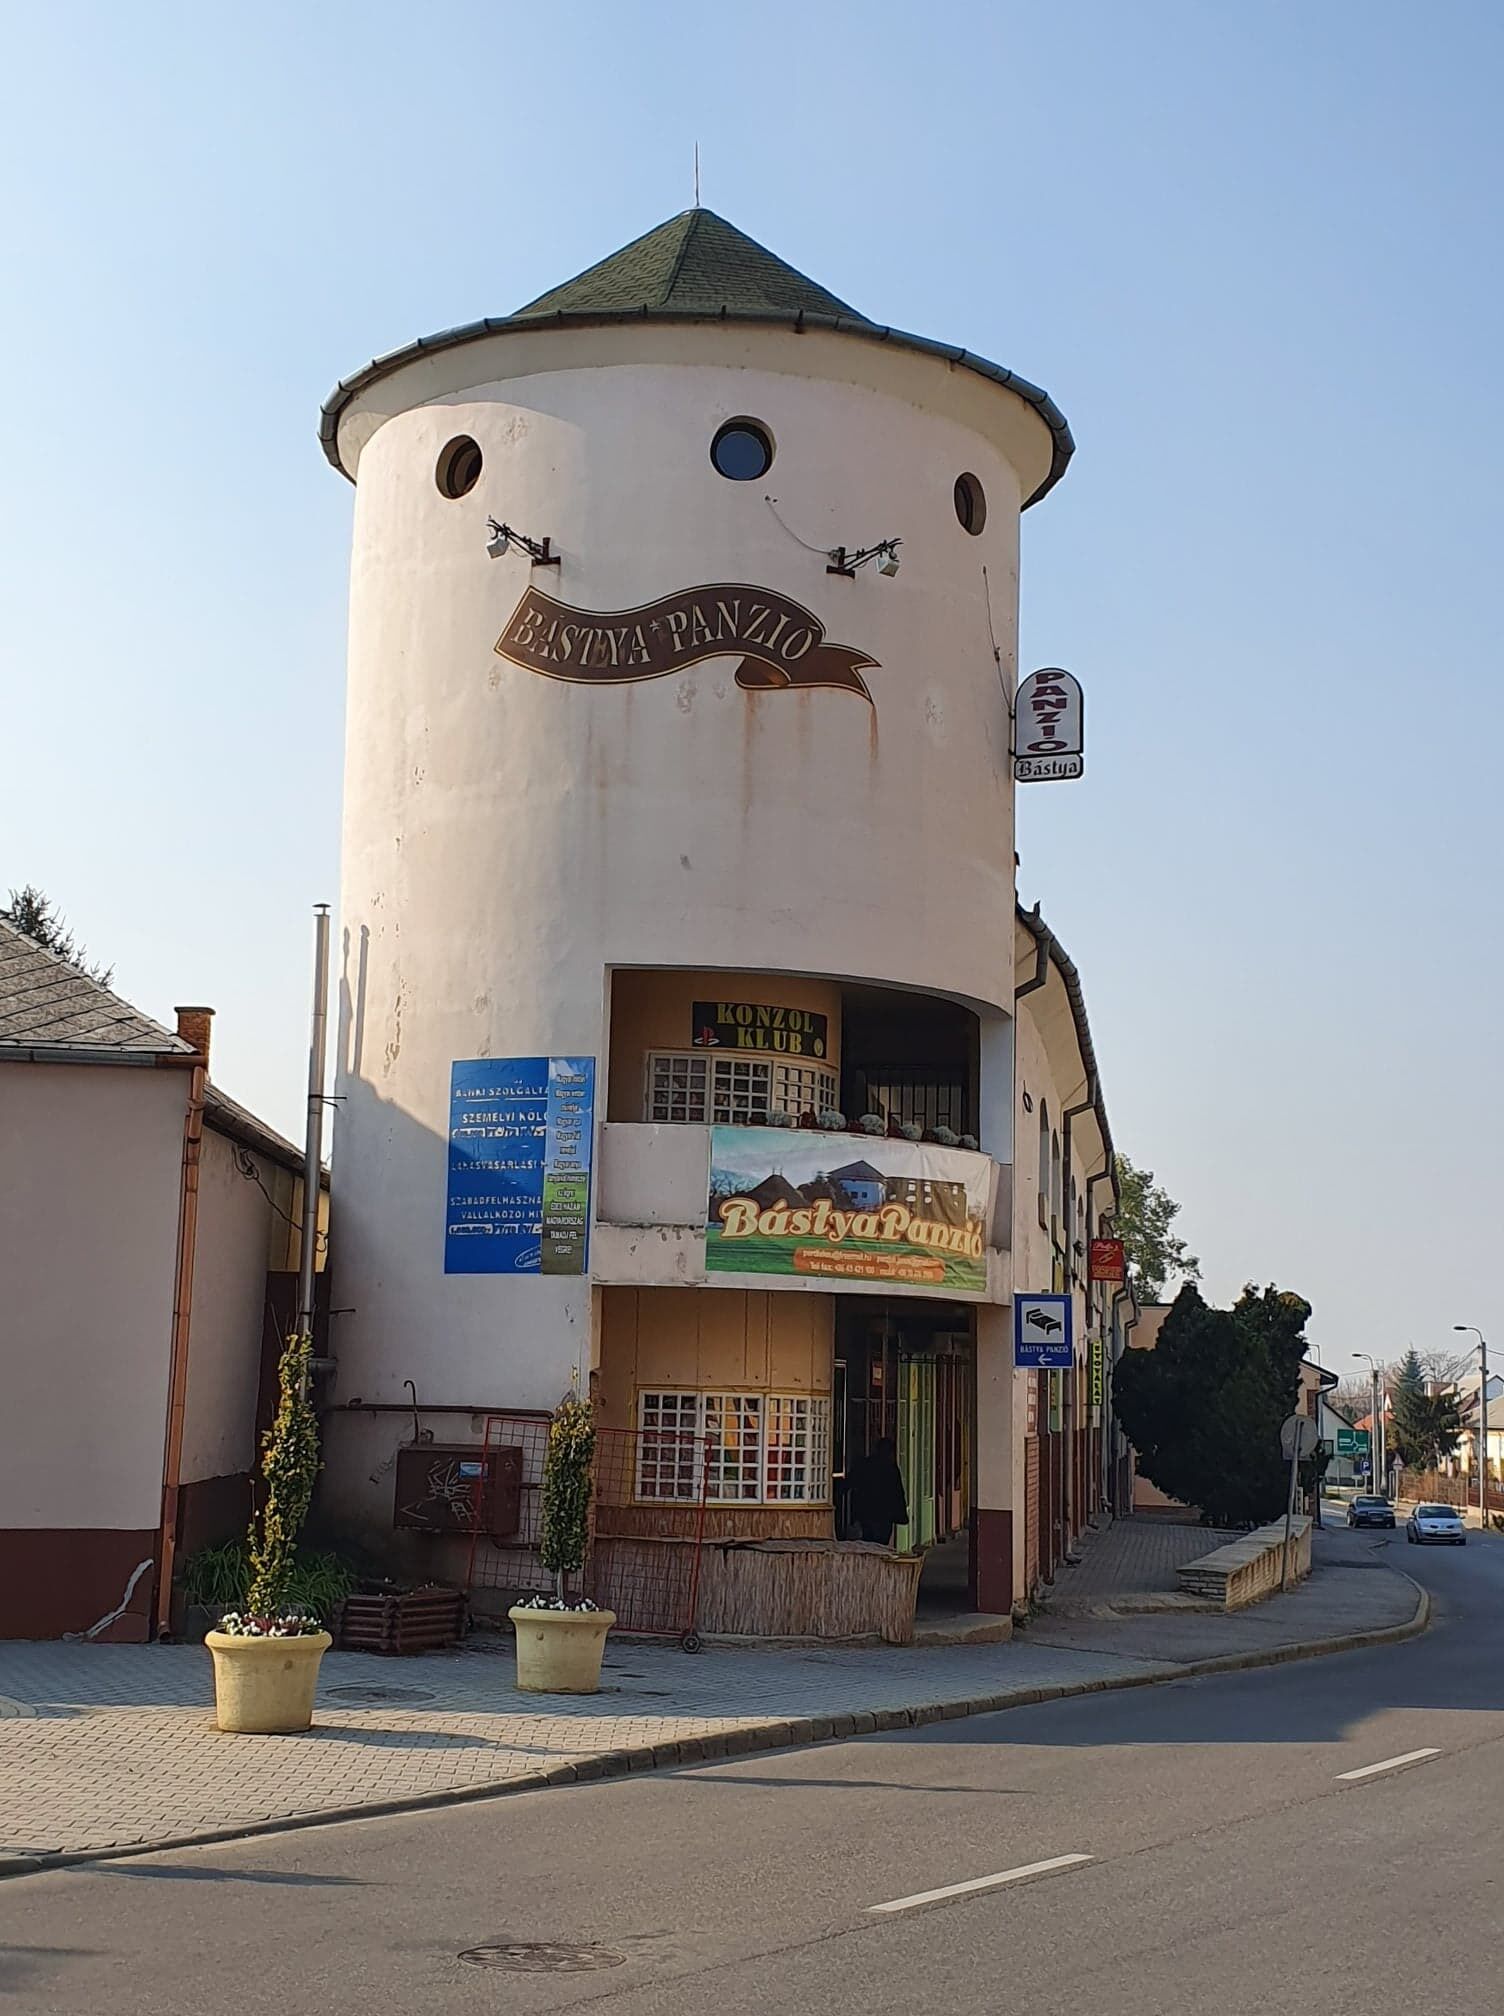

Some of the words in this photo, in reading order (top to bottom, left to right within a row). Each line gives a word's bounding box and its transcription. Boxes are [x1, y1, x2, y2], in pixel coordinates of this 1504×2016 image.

[510, 607, 651, 666] BÁSTYA
[665, 599, 820, 661] PANZIÓ
[1018, 760, 1078, 778] Bástya
[717, 1004, 813, 1033] KONZOL
[737, 1027, 802, 1053] KLUB
[719, 1197, 880, 1242] Bástya
[880, 1203, 983, 1258] Panzió
